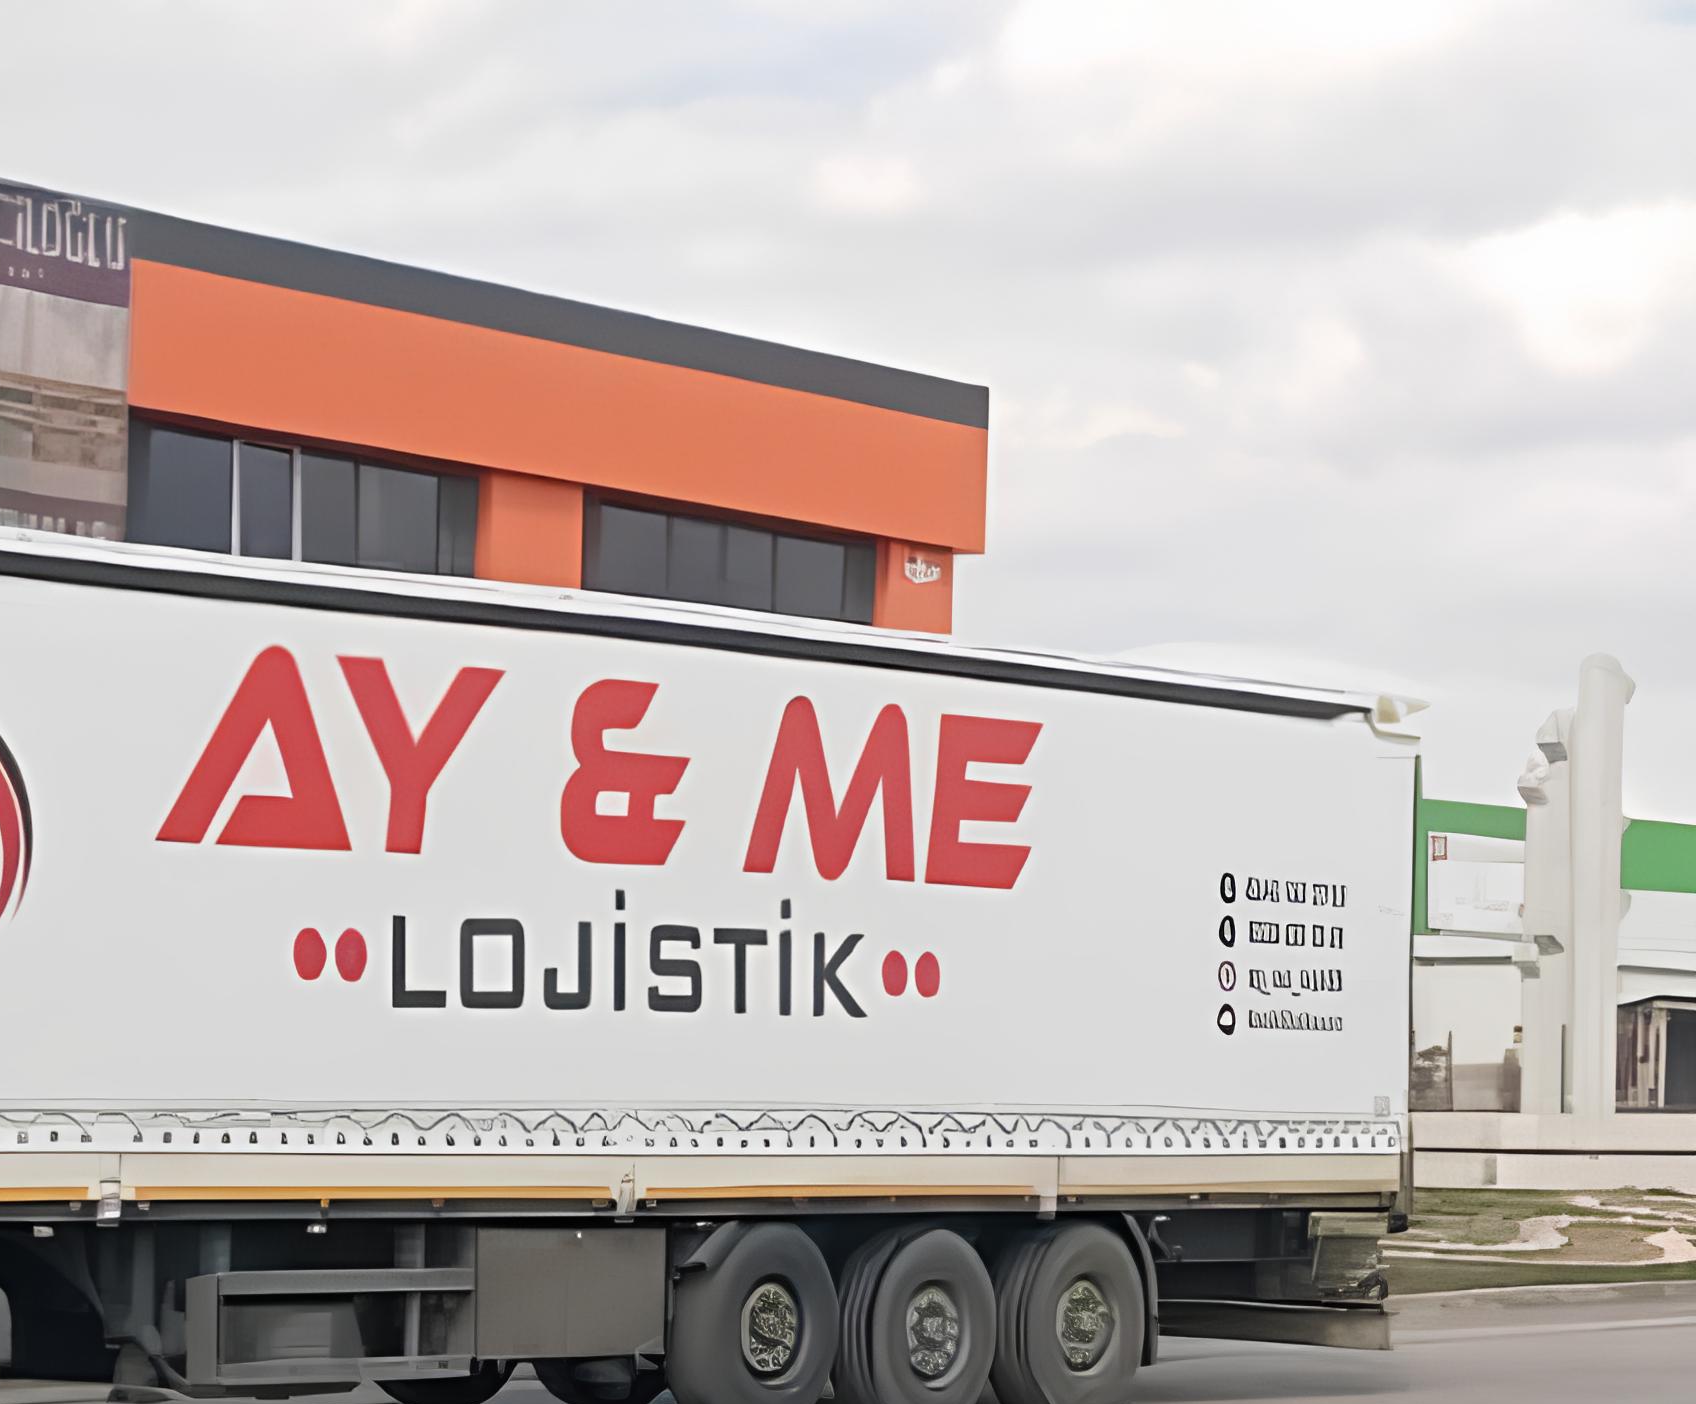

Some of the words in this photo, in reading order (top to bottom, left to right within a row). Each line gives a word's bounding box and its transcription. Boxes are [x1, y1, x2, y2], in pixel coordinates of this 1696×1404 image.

[156, 644, 506, 855] AY
[560, 678, 692, 866] &
[742, 695, 1044, 889] ME
[392, 889, 868, 1018] LOJİSTİK
